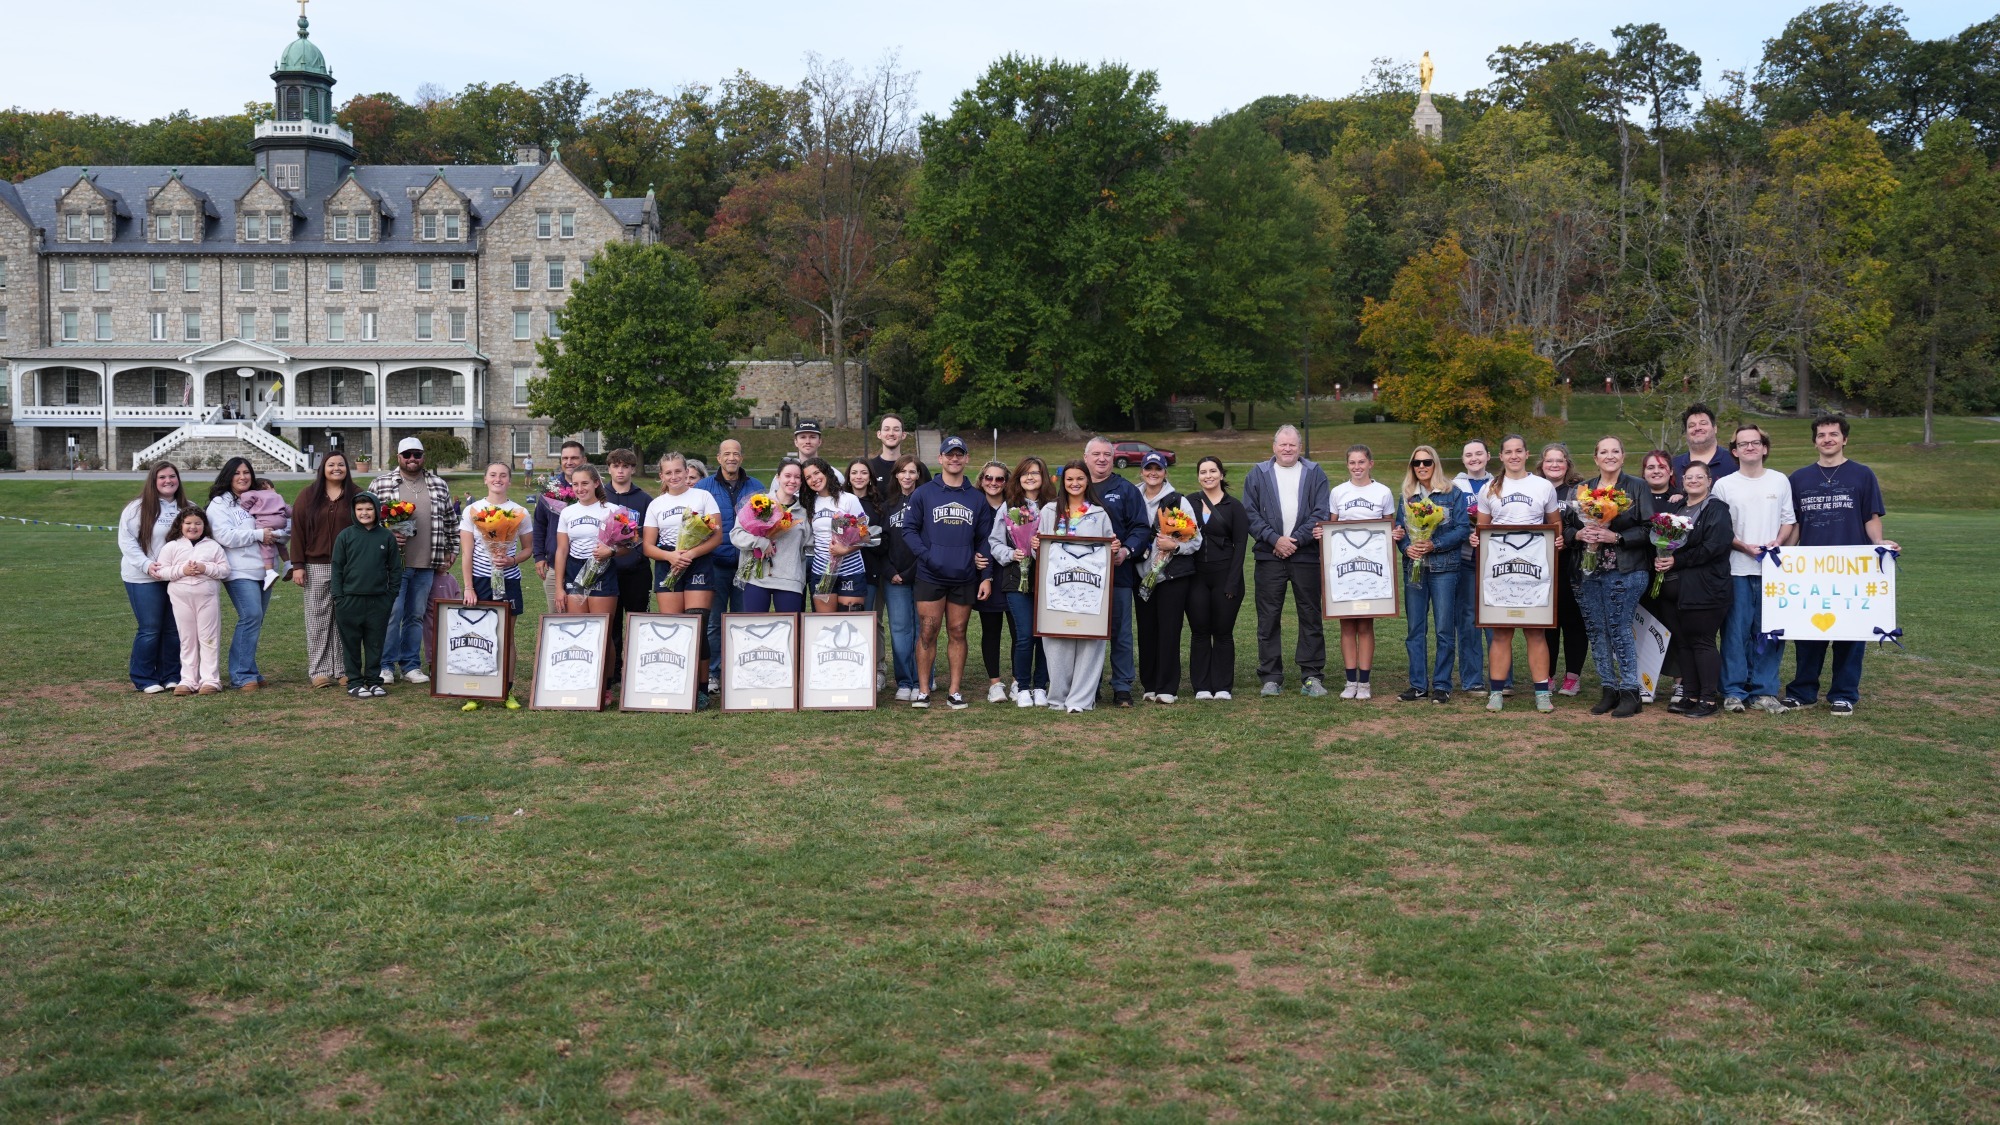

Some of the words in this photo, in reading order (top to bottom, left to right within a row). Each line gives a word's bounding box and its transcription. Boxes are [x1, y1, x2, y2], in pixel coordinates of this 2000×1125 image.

[1513, 495, 1532, 506] MOUNT
[934, 508, 949, 520] THE
[949, 507, 973, 522] MOUNT
[1337, 562, 1353, 577] THE
[1355, 562, 1382, 576] MOUNT
[1493, 564, 1510, 578] THE
[1512, 563, 1541, 579] MOUNT
[1782, 555, 1806, 574] GO
[691, 574, 706, 584] M
[841, 580, 854, 590] M
[1055, 572, 1071, 586] THE
[1072, 571, 1101, 588] MOUNT
[1788, 583, 1858, 596] CALI
[1866, 581, 1889, 596] #3
[1779, 597, 1870, 609] DIETZ
[451, 637, 466, 650] THE
[467, 637, 493, 654] MOUNT
[552, 651, 568, 665] THE
[569, 650, 592, 664] MOUNT
[641, 653, 657, 666] THE
[659, 653, 685, 668] MOUNT
[740, 652, 756, 666] THE
[757, 651, 784, 664] MOUNT
[818, 652, 834, 665] THE
[836, 652, 864, 665] MOUNT
